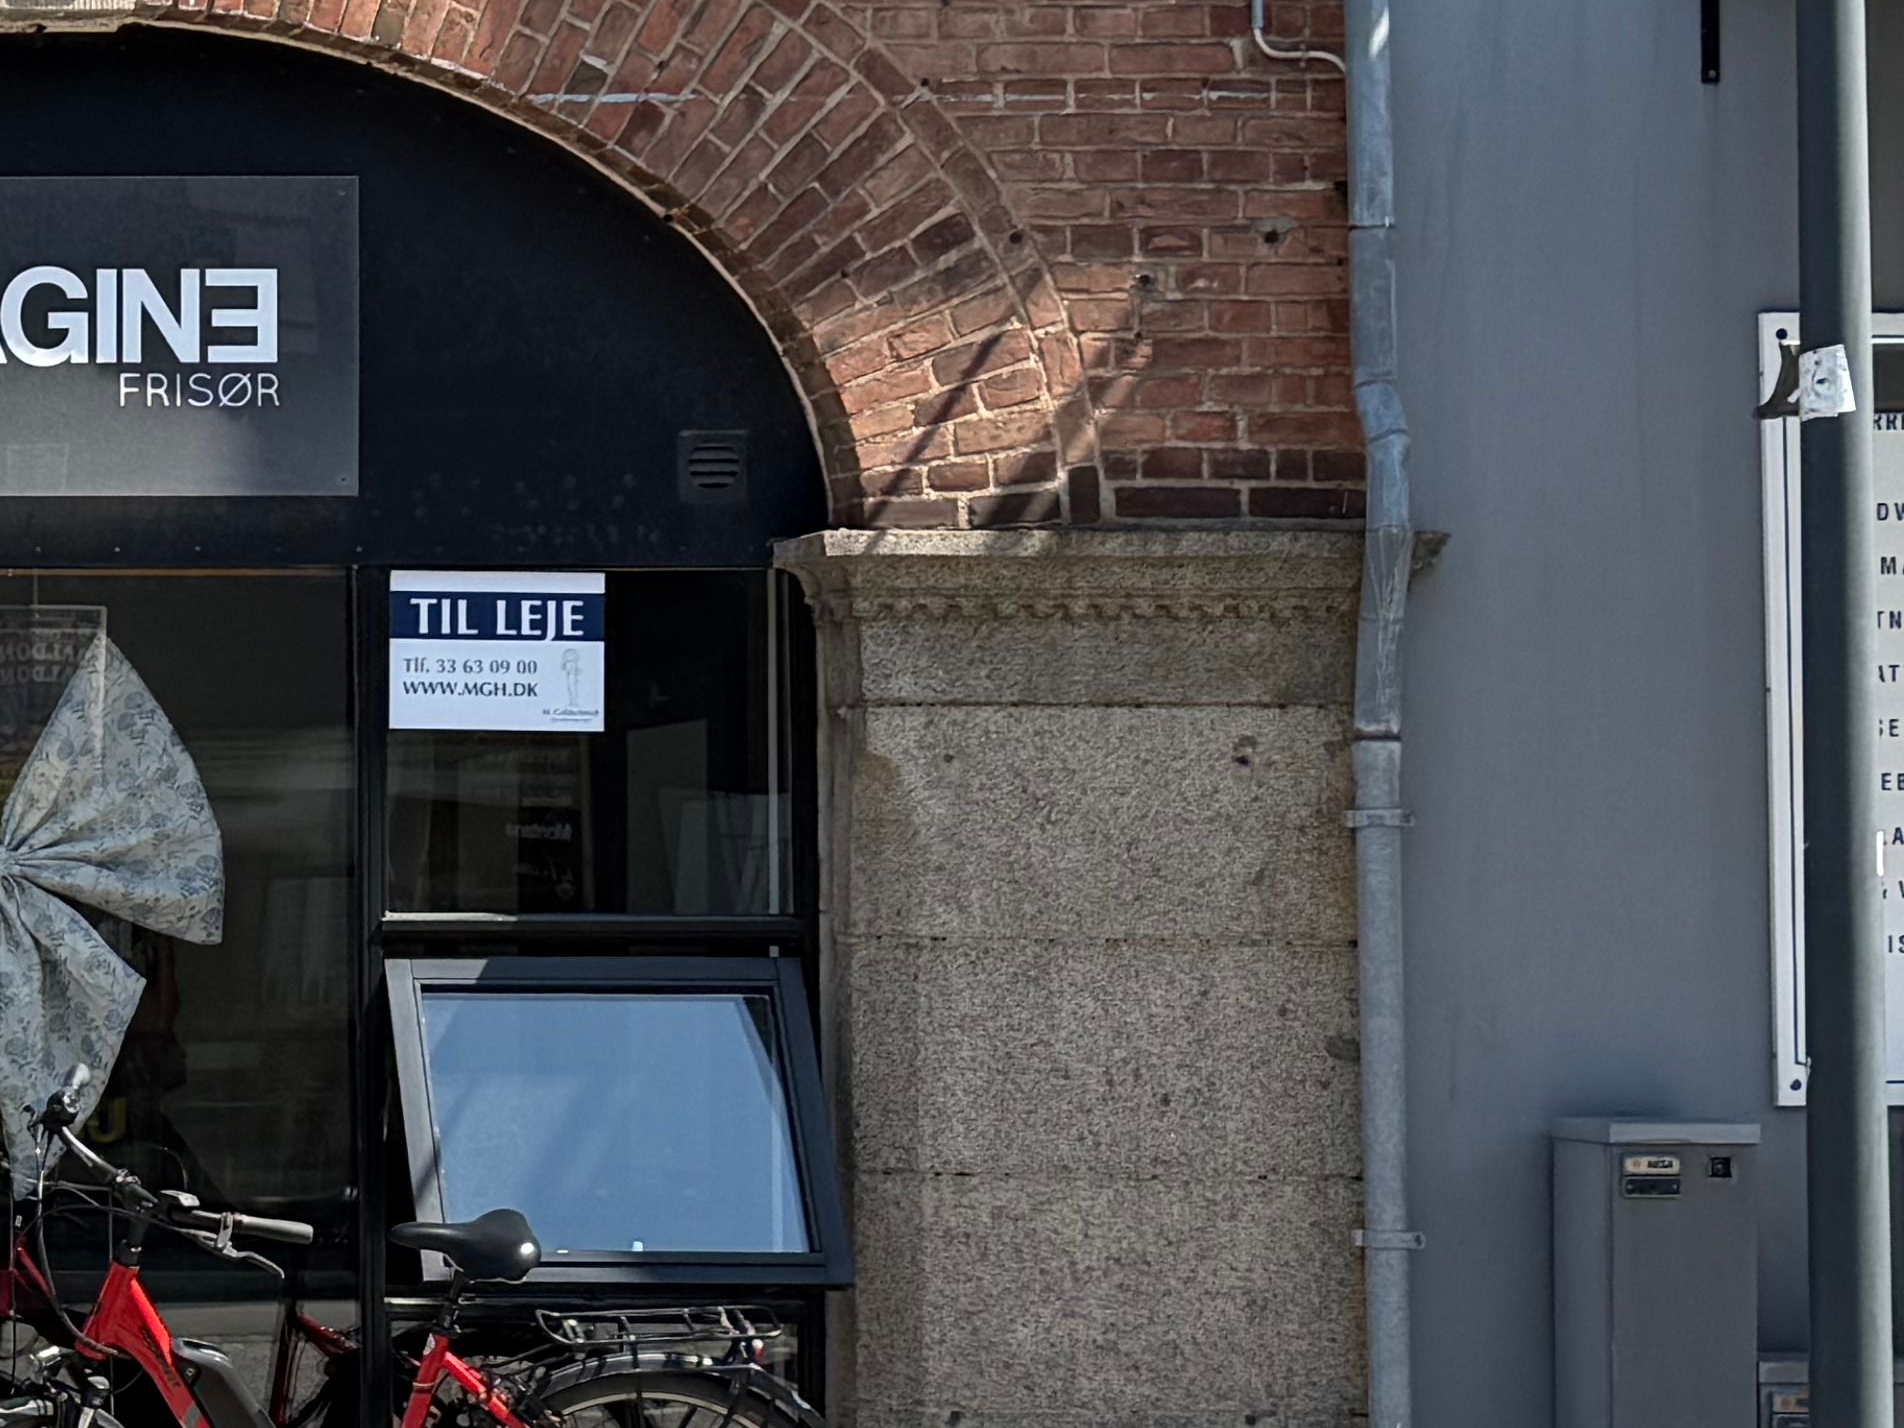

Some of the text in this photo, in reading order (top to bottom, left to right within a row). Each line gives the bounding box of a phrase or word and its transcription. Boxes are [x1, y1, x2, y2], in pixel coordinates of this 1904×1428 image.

[119, 372, 280, 408] FRISØR
[409, 598, 585, 641] TIL LEJE
[402, 657, 538, 675] Tlf. 33 63 09 00
[402, 681, 538, 698] WWW.MGH.DK
